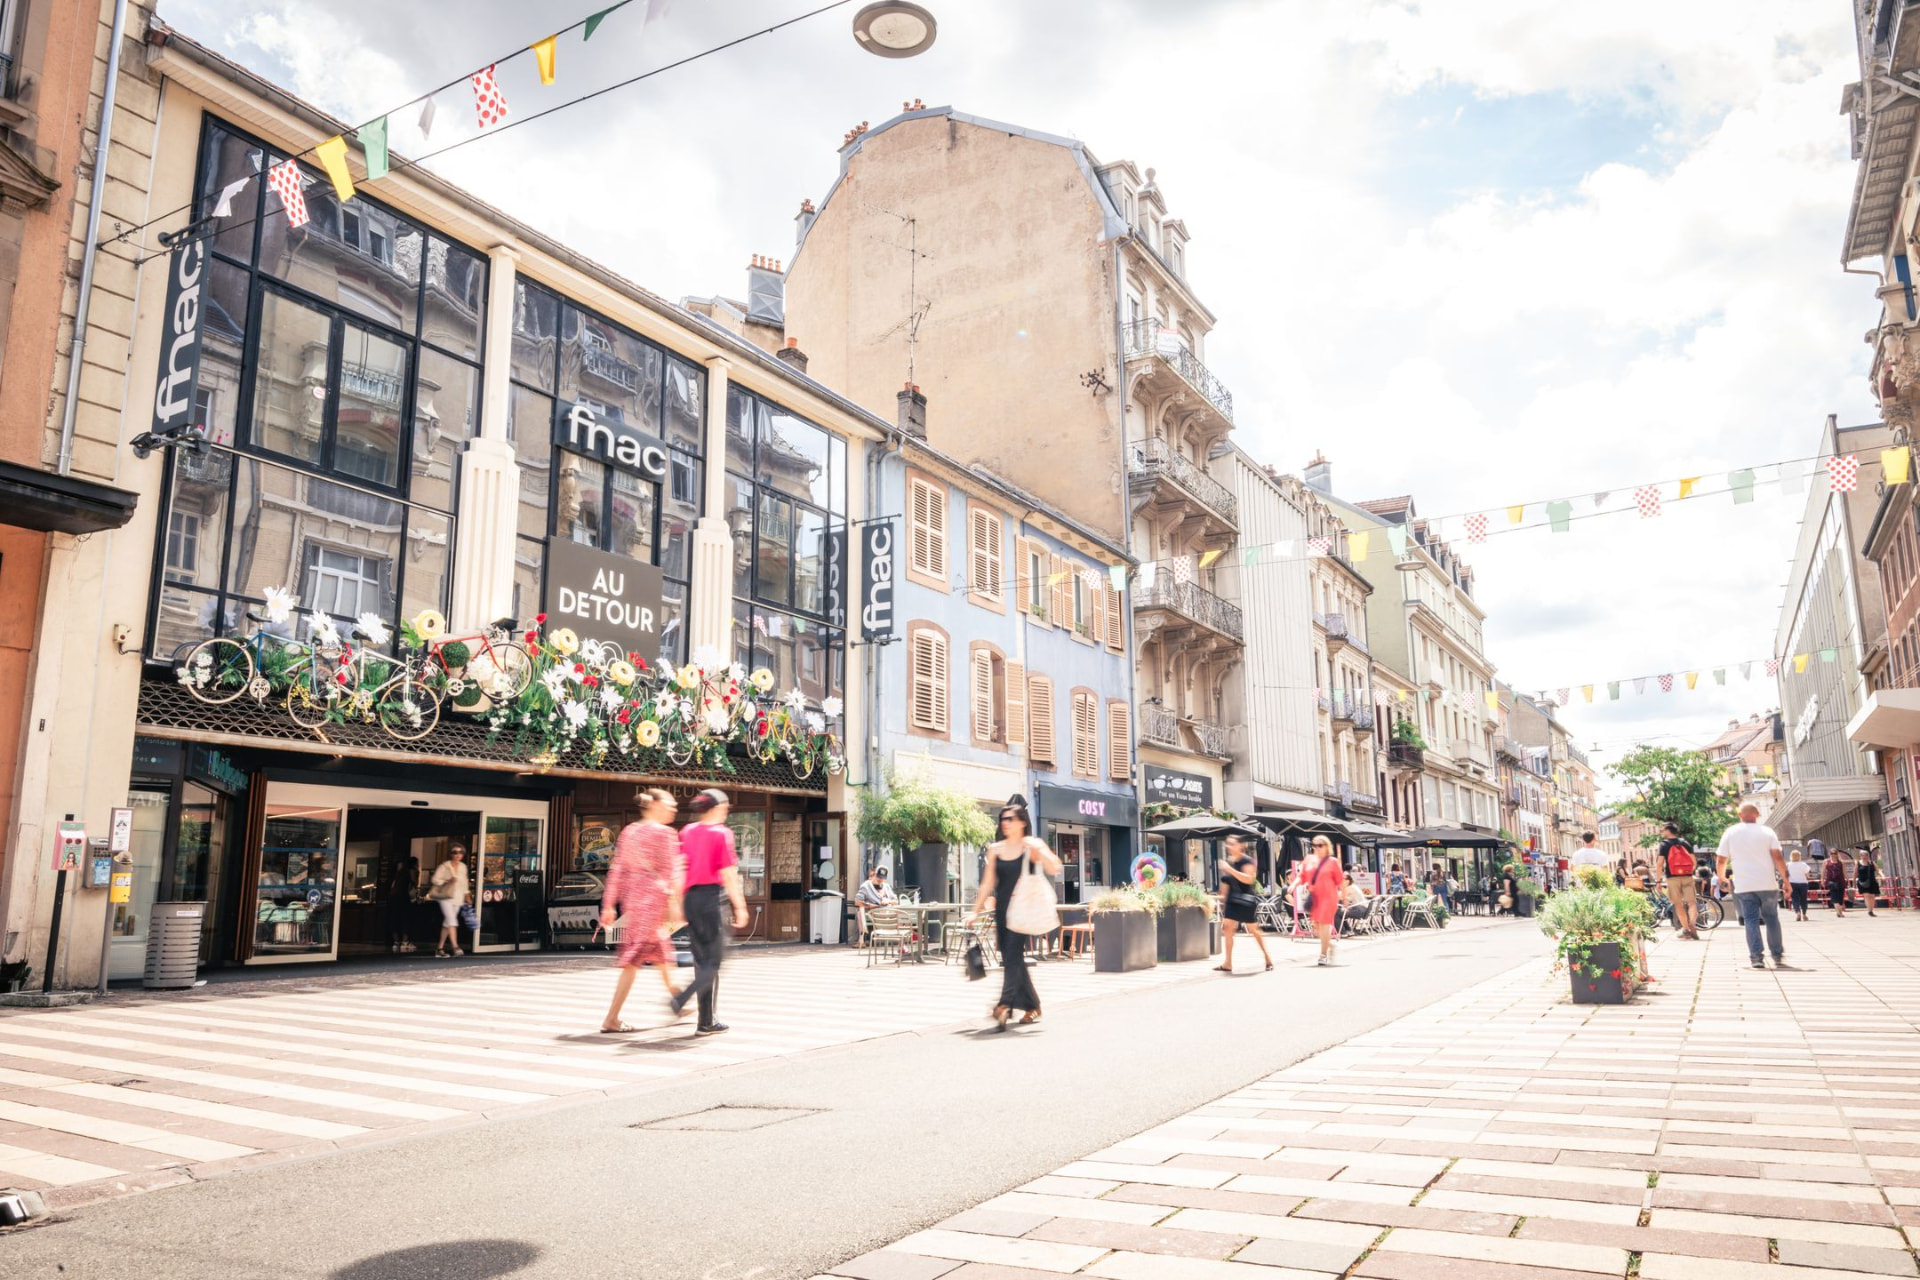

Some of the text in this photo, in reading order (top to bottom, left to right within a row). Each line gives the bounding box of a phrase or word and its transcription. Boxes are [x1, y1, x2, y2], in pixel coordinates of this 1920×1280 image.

[157, 239, 205, 424] fnac
[569, 405, 667, 476] fnac
[592, 567, 625, 597] AU
[863, 527, 892, 632] fnac
[558, 587, 654, 633] DETOUR
[1078, 799, 1106, 817] COSY
